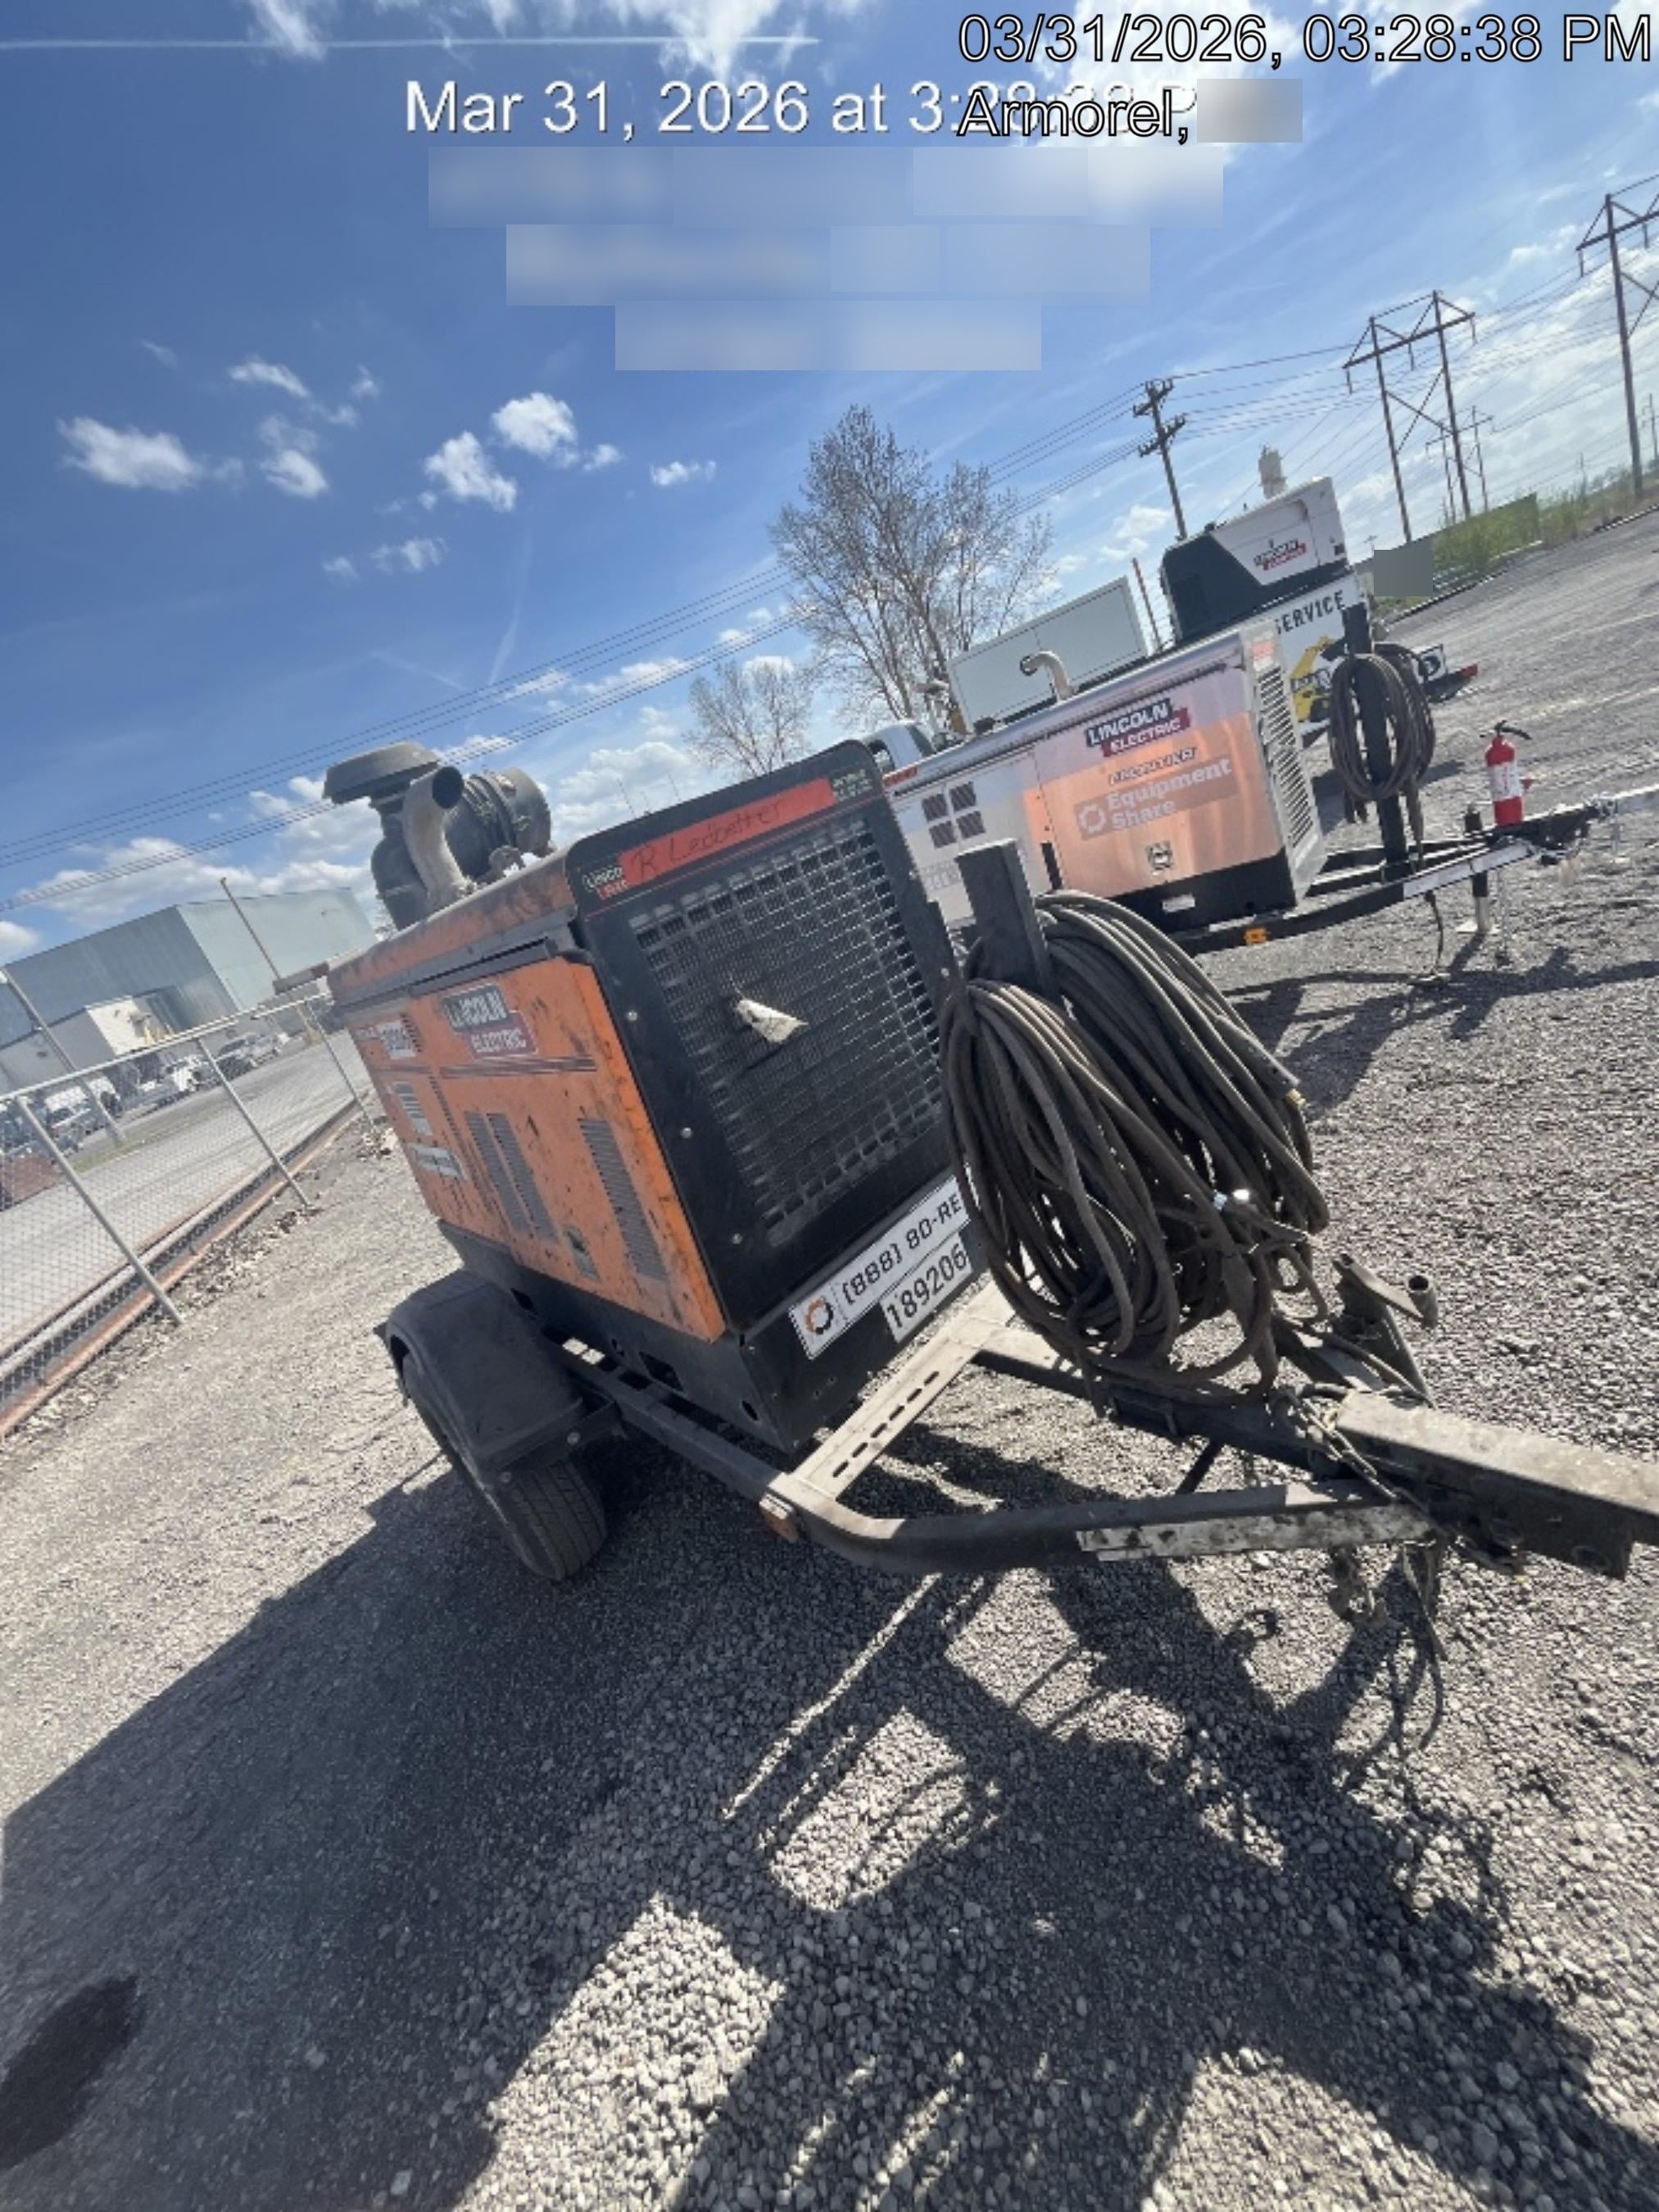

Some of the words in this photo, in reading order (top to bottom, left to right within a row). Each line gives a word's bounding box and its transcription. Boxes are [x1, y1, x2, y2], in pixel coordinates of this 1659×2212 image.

[1088, 702, 1169, 745] LINCOLN
[1109, 718, 1181, 751] ELECTRIC
[1107, 759, 1233, 809] Equipment
[1113, 800, 1176, 831] Share
[841, 1242, 904, 1304] (888)
[886, 1242, 968, 1329] 189206
